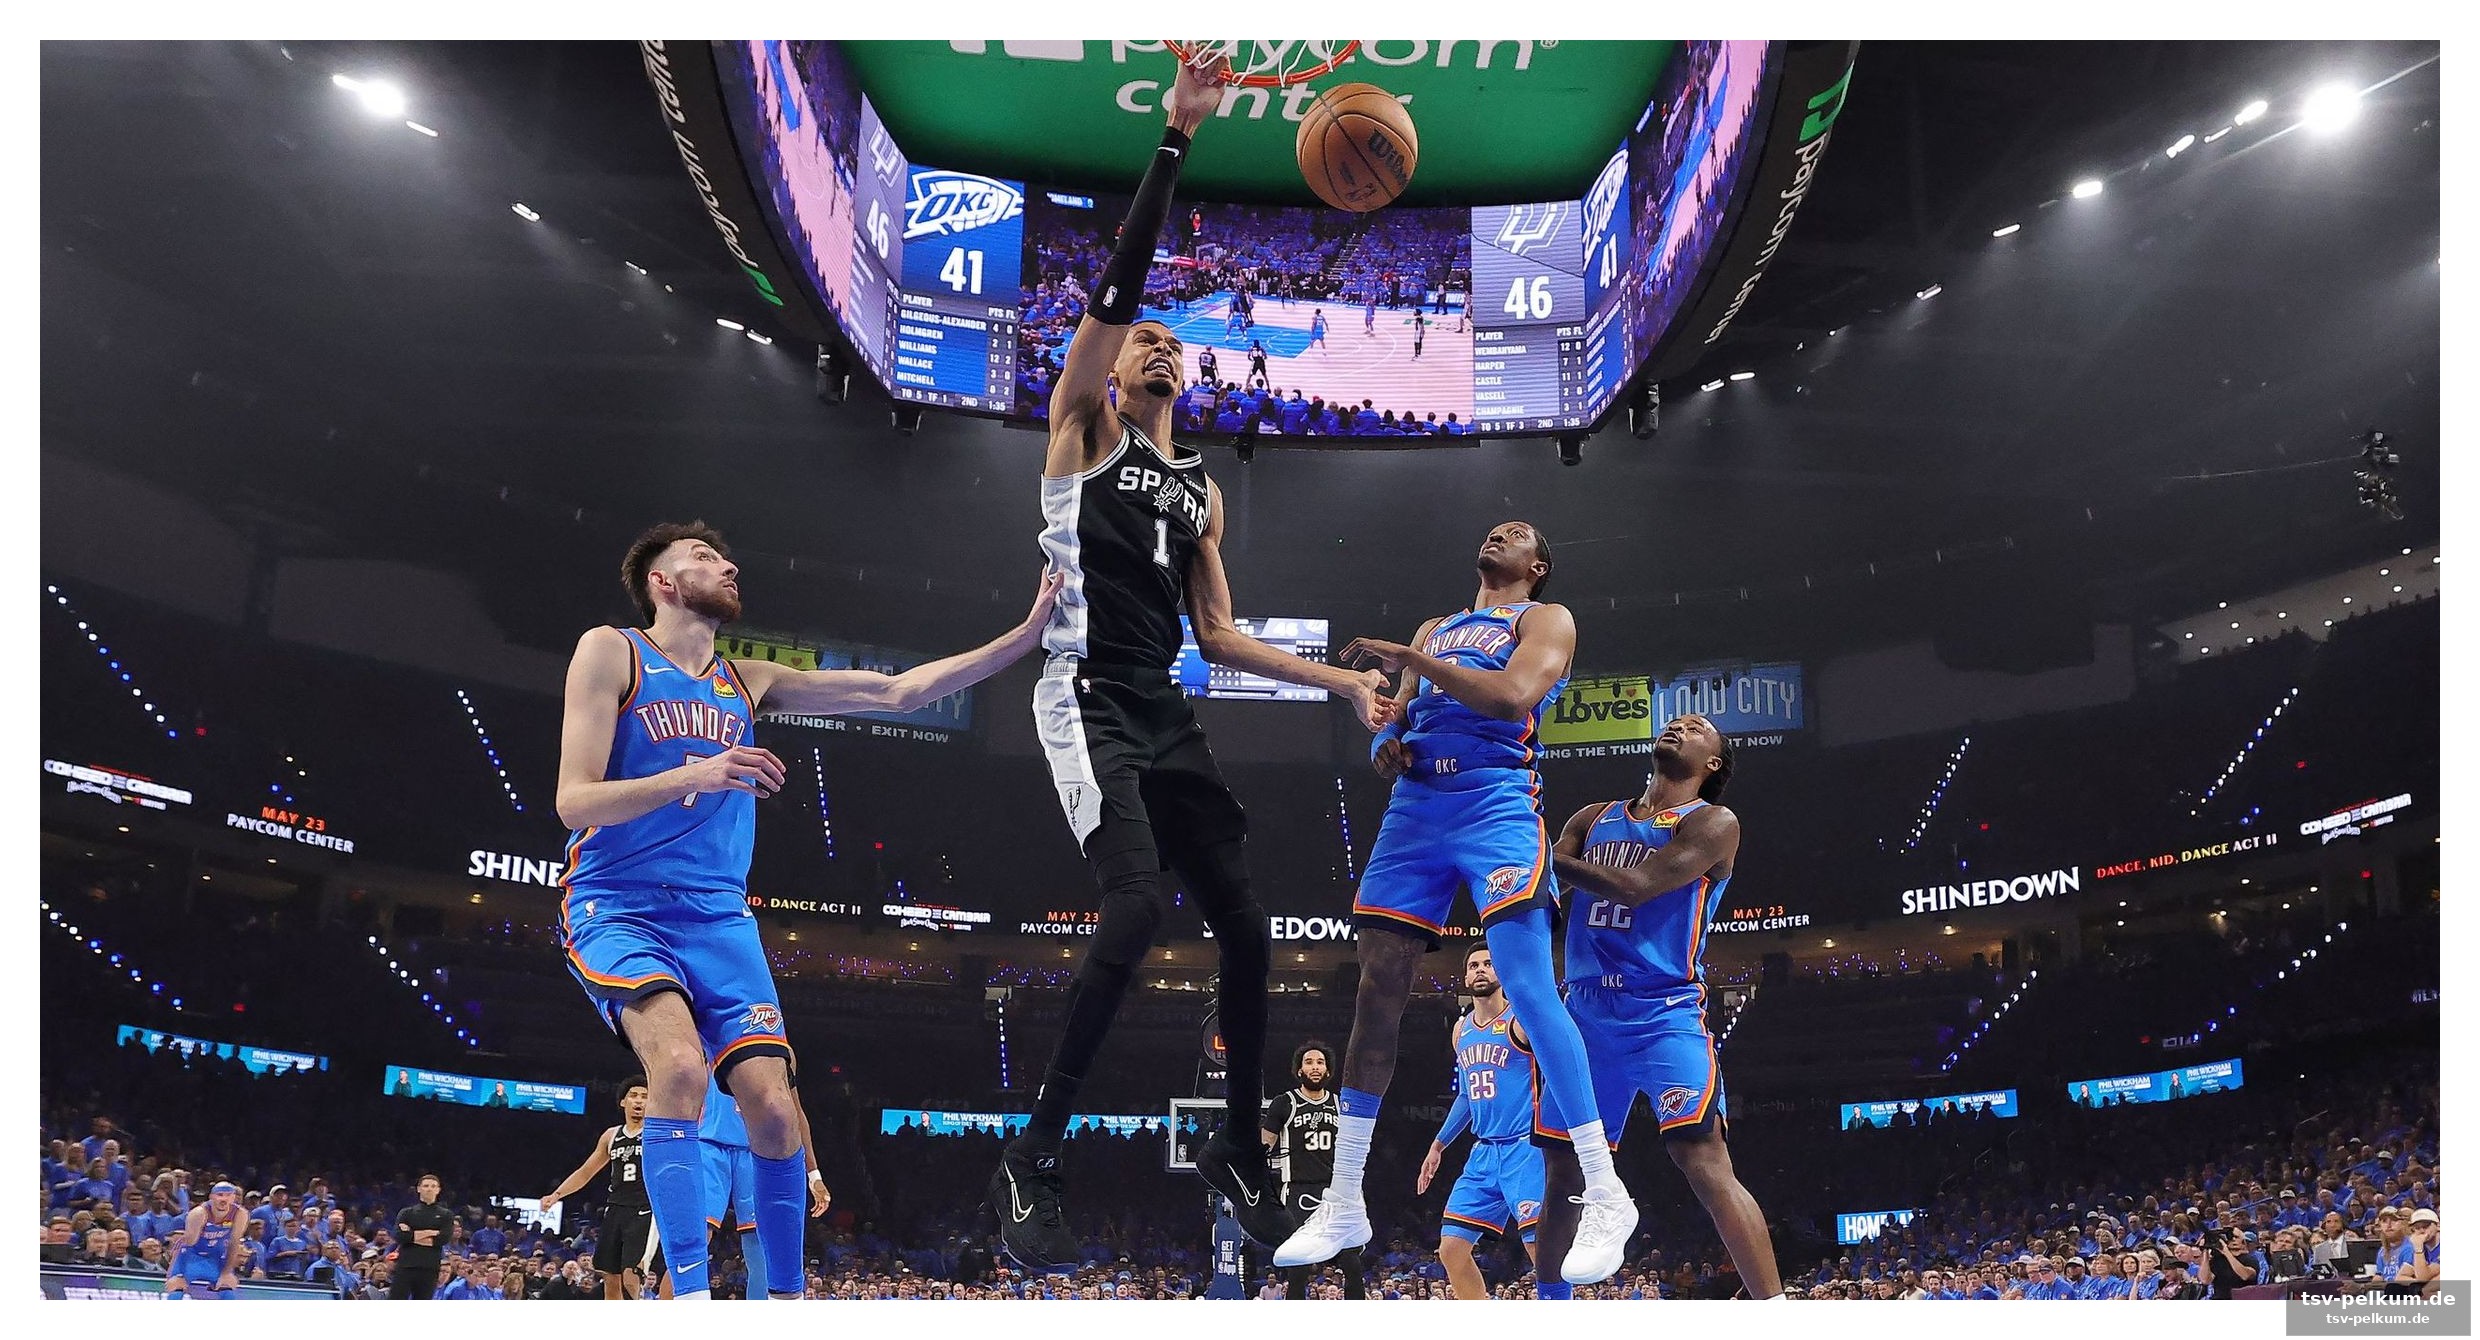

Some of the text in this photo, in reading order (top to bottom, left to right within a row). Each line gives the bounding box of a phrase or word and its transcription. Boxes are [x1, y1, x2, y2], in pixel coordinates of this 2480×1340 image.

[672, 129, 758, 268] paycom
[1754, 132, 1827, 267] paycom
[866, 198, 890, 260] 46
[939, 246, 984, 295] 41
[902, 294, 1016, 320] PLAYER PTS FL
[1504, 276, 1553, 320] 46
[1476, 326, 1583, 341] PLAYER PTS FL
[916, 390, 922, 399] 5
[962, 396, 978, 407] 2ND
[988, 401, 1006, 411] 1:35
[1538, 420, 1554, 429] 2ND
[1564, 418, 1580, 428] 1:35
[1153, 518, 1170, 568] 1
[1658, 677, 1795, 730] LOUD CITY
[635, 701, 747, 749] THUNDER
[768, 714, 949, 744] THUNDER EXIT NOW
[1576, 746, 1606, 758] THE
[1748, 736, 1783, 747] NOW
[1436, 758, 1457, 773] OKC
[262, 806, 326, 832] MAY 23
[226, 813, 354, 854] PAYCOM CENTER
[2181, 843, 2231, 863] DANCE
[2233, 836, 2261, 853] ACT
[1902, 866, 2080, 917] SHINEDOWN
[770, 898, 816, 912] DANCE
[820, 902, 846, 914] ACT
[1047, 911, 1100, 923] MAY 23
[1733, 906, 1785, 919] MAY 23
[1020, 922, 1072, 935] PAYCOM
[1708, 914, 1810, 934] PAYCOM CENTER
[1602, 974, 1623, 988] OKC
[1458, 1044, 1509, 1070] THUNDER
[1470, 1070, 1495, 1100] 25
[942, 1112, 1002, 1122] PHIL WICKHAM
[1304, 1130, 1332, 1151] 30
[623, 1163, 637, 1182] 2
[1221, 1252, 1234, 1262] THE
[1222, 1240, 1234, 1251] GET
